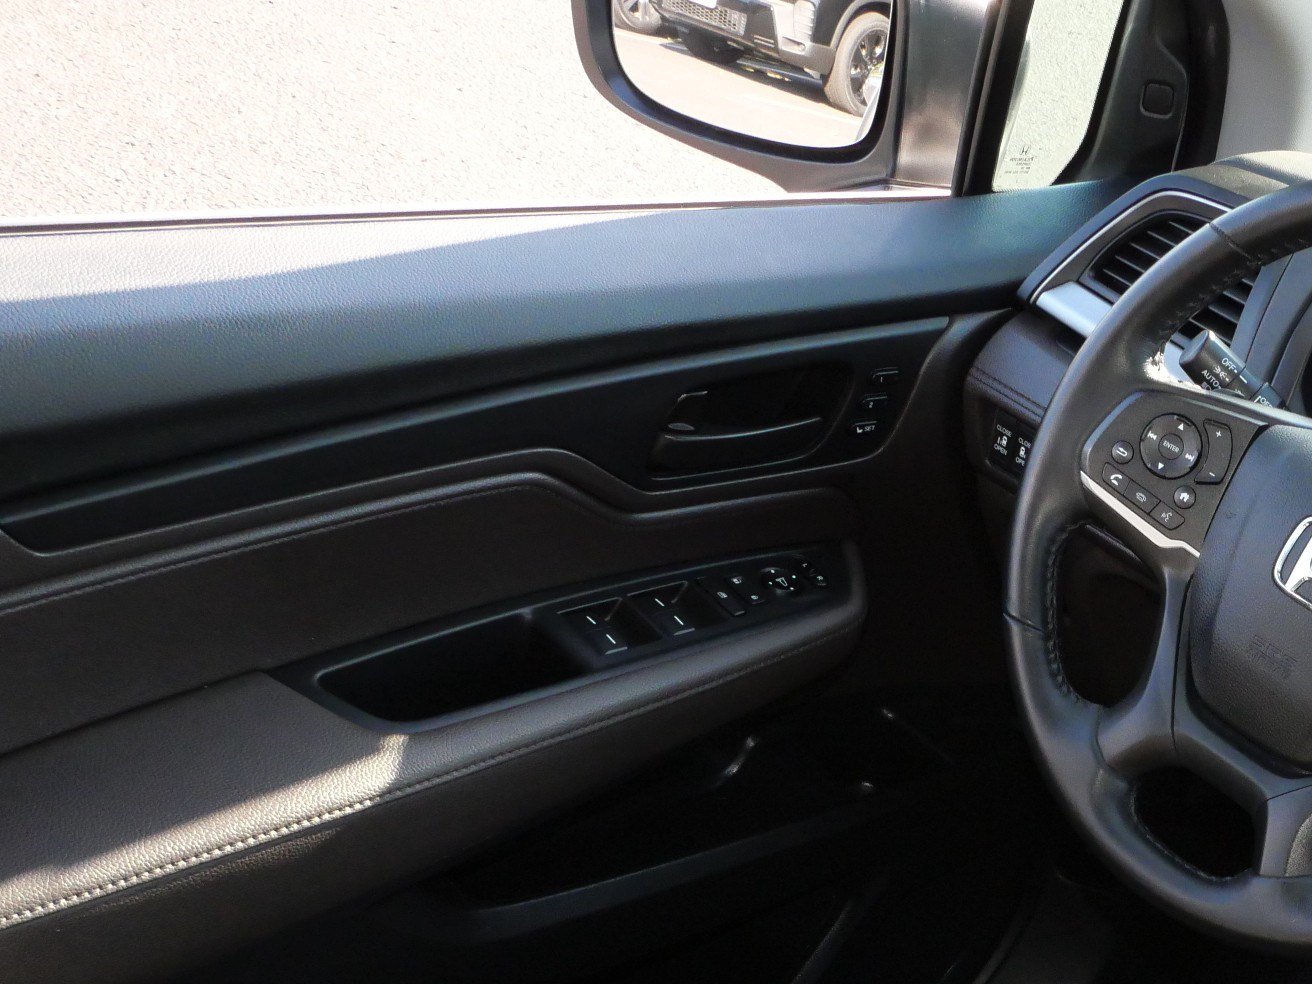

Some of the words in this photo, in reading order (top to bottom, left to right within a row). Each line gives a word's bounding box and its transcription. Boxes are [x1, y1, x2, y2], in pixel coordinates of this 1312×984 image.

[1221, 357, 1236, 372] OFF
[1201, 369, 1220, 387] AUTO
[996, 424, 1012, 438] CLOSE
[993, 443, 1008, 456] OPEN
[1018, 437, 1031, 449] CLOS
[1162, 440, 1180, 453] ENTER
[1015, 456, 1026, 467] OPE
